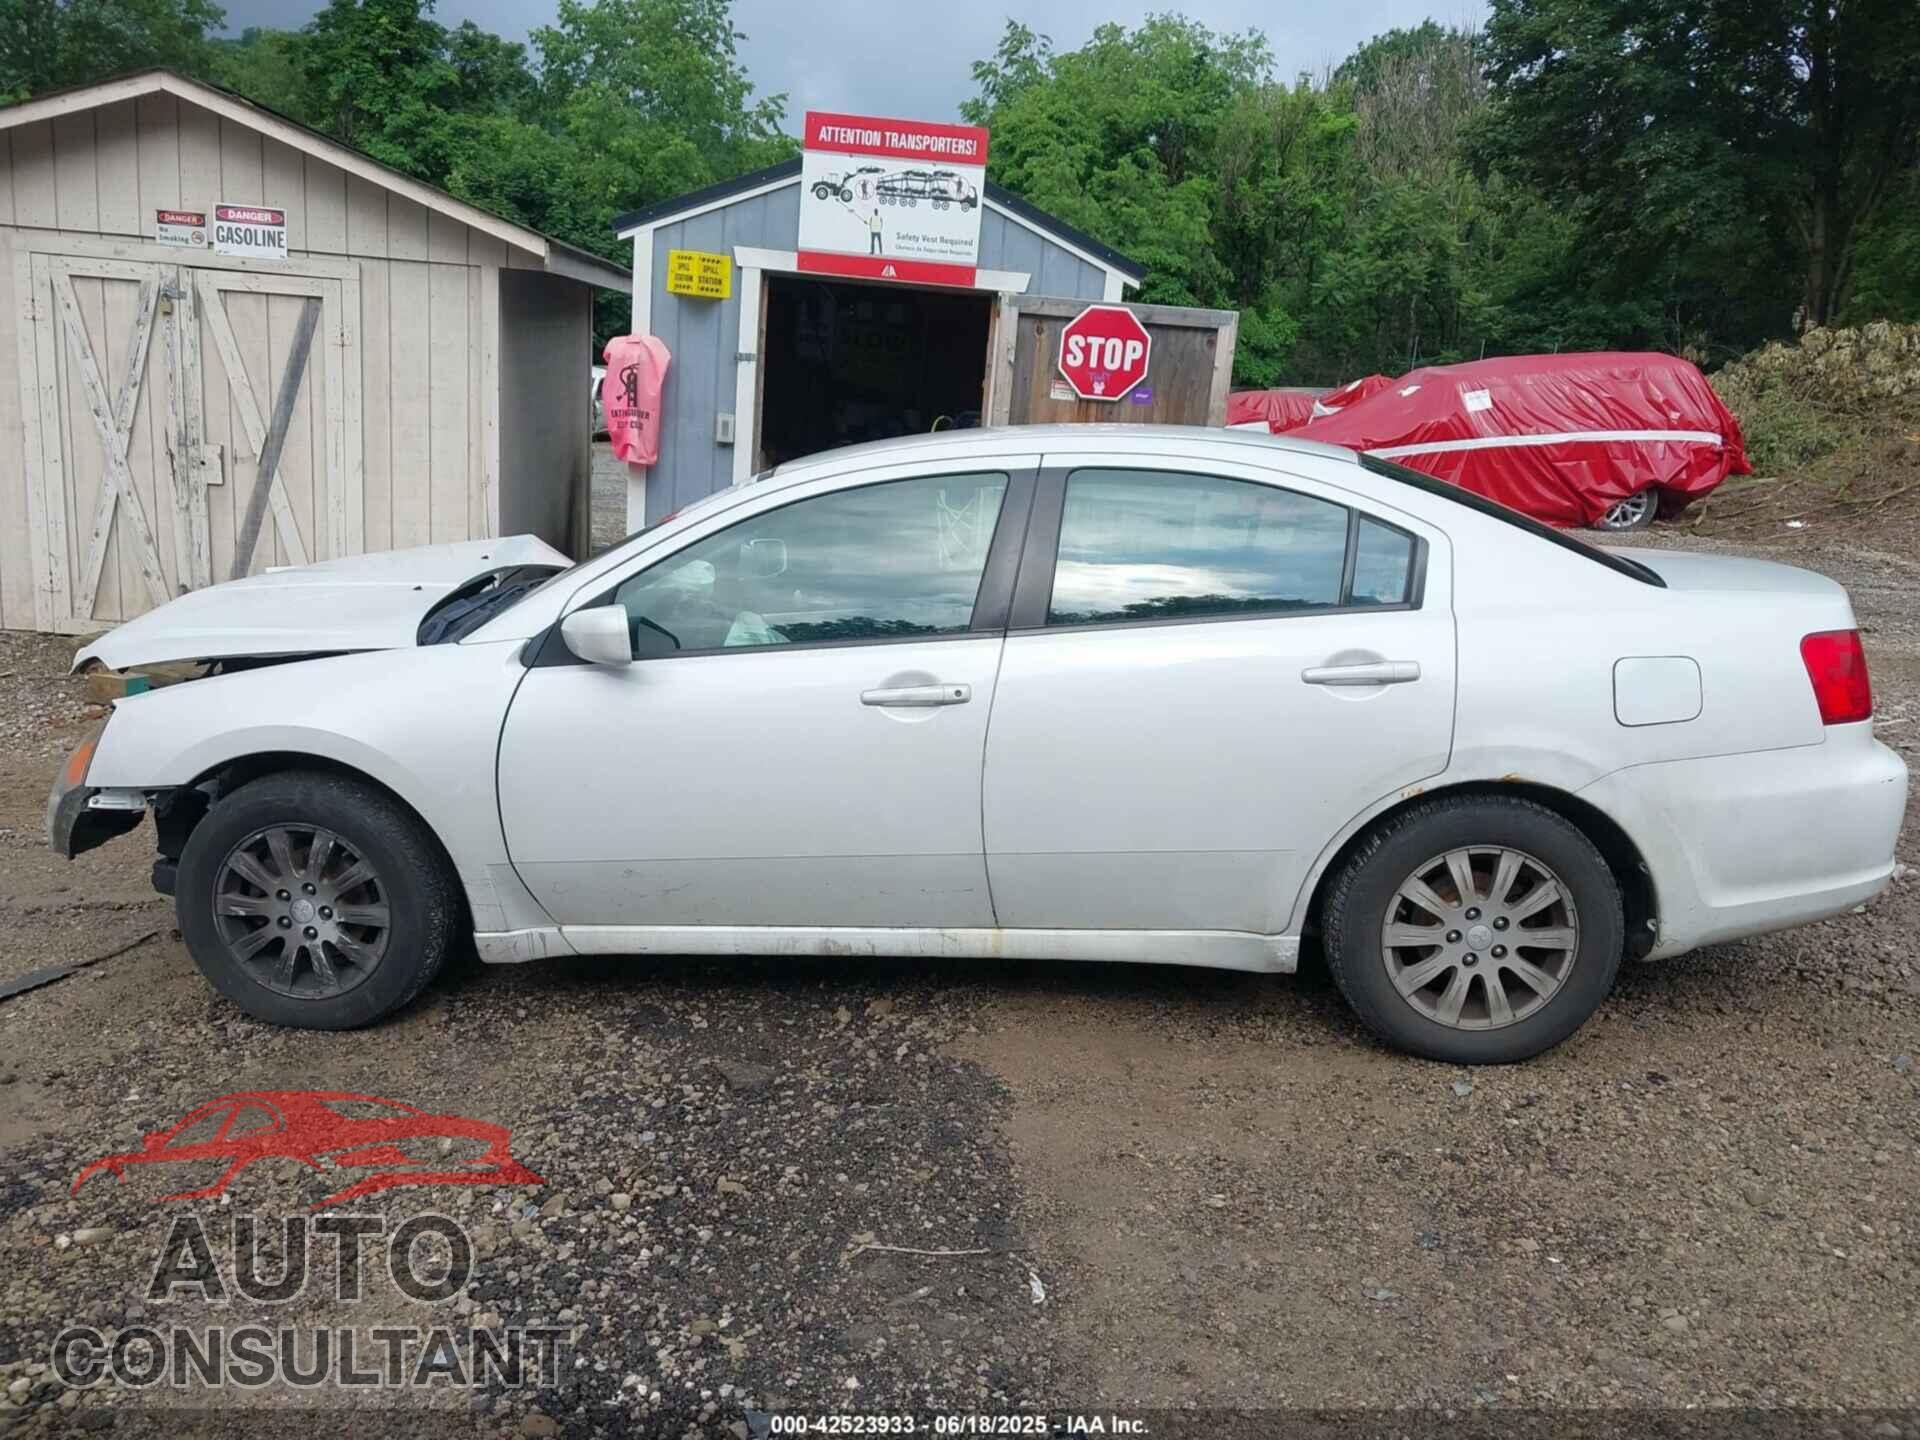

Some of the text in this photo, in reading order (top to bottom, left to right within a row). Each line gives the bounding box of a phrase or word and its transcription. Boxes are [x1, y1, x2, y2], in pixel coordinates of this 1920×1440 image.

[818, 125, 977, 156] ATTENTION TRANSPORTERS!
[164, 212, 197, 224] DANGER
[228, 209, 272, 222] DANGER
[216, 225, 285, 249] GASOLINE
[896, 231, 974, 247] Safety Vest Required
[1066, 334, 1144, 372] STOP
